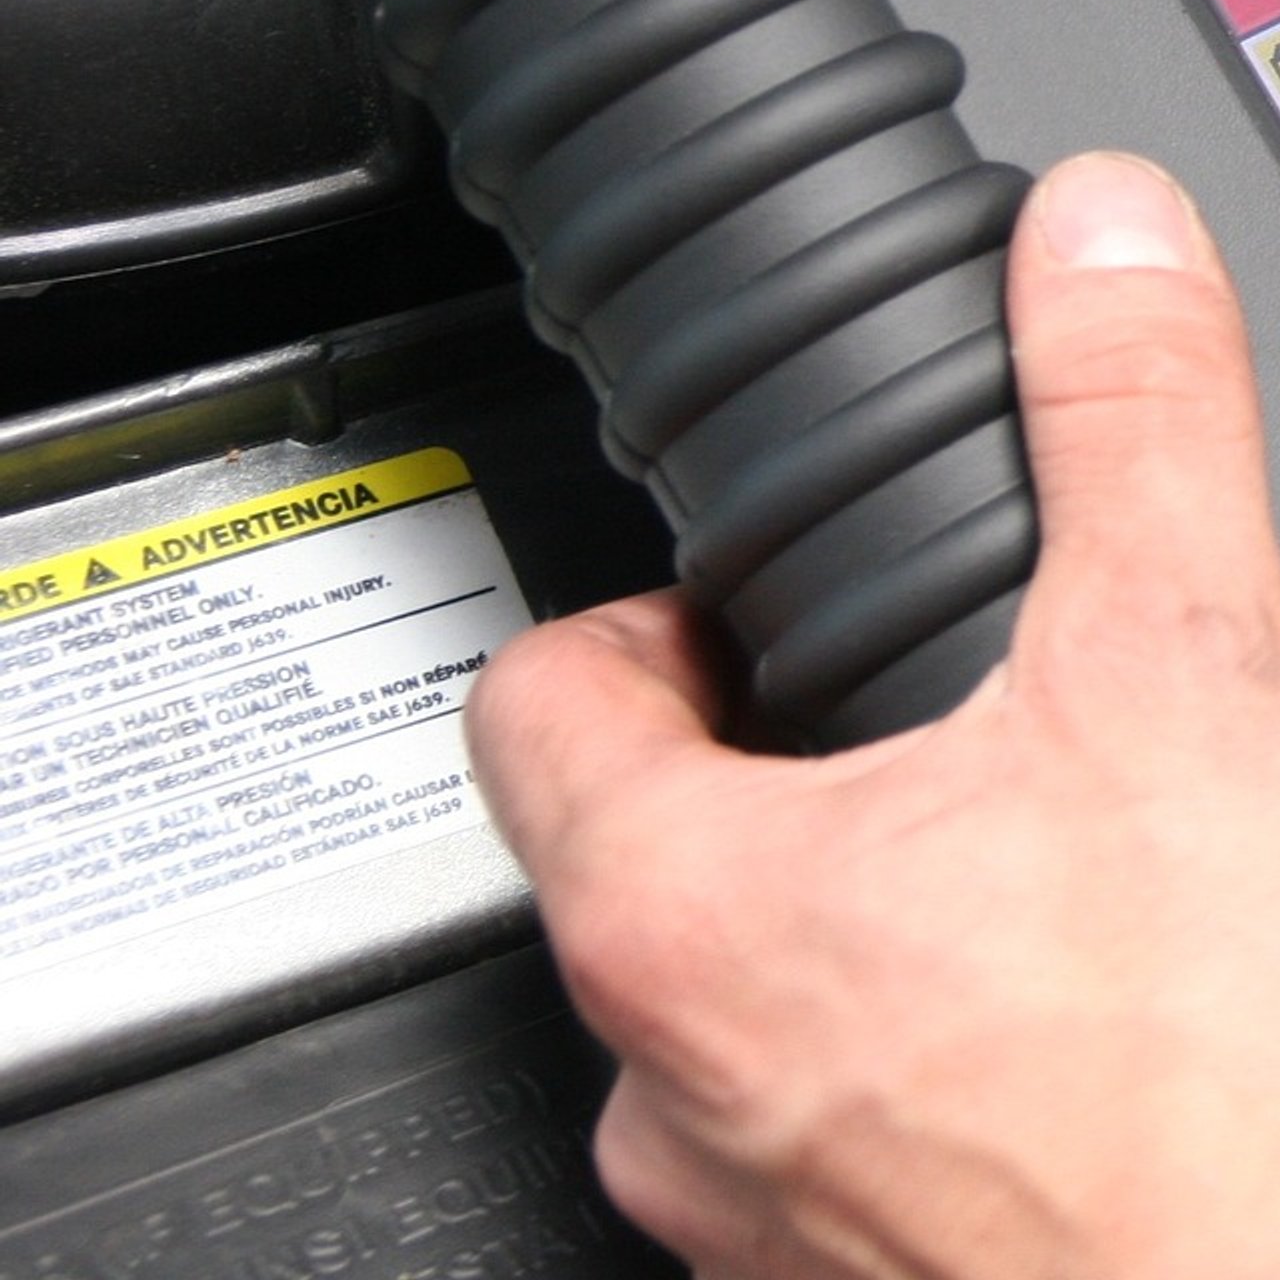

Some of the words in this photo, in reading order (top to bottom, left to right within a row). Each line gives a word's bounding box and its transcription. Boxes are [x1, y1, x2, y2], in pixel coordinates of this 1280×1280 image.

[136, 479, 380, 571] ADVERTENCIA
[58, 602, 196, 657] PERSONNEL
[197, 581, 264, 615] ONLY.
[107, 577, 200, 620] SYSTEM
[121, 641, 163, 665] MAY
[164, 621, 226, 652] CAUSE
[226, 593, 321, 634] PERSONAL
[322, 571, 393, 606] INJURY.
[107, 670, 145, 693] SAE
[147, 639, 243, 681] STANDARD
[51, 718, 116, 753] SOUS
[119, 694, 198, 732] HAUTE
[198, 658, 312, 709] PRESSION
[72, 742, 207, 794] CORPORELLES
[259, 694, 356, 737] POSSIBLES
[379, 673, 421, 699] NON
[270, 736, 297, 757] LA
[296, 714, 366, 749] NORME
[366, 702, 403, 727] SAE
[68, 713, 211, 772] TECHNICIEN
[388, 771, 465, 809] CAUSAR
[382, 806, 423, 835] SAE
